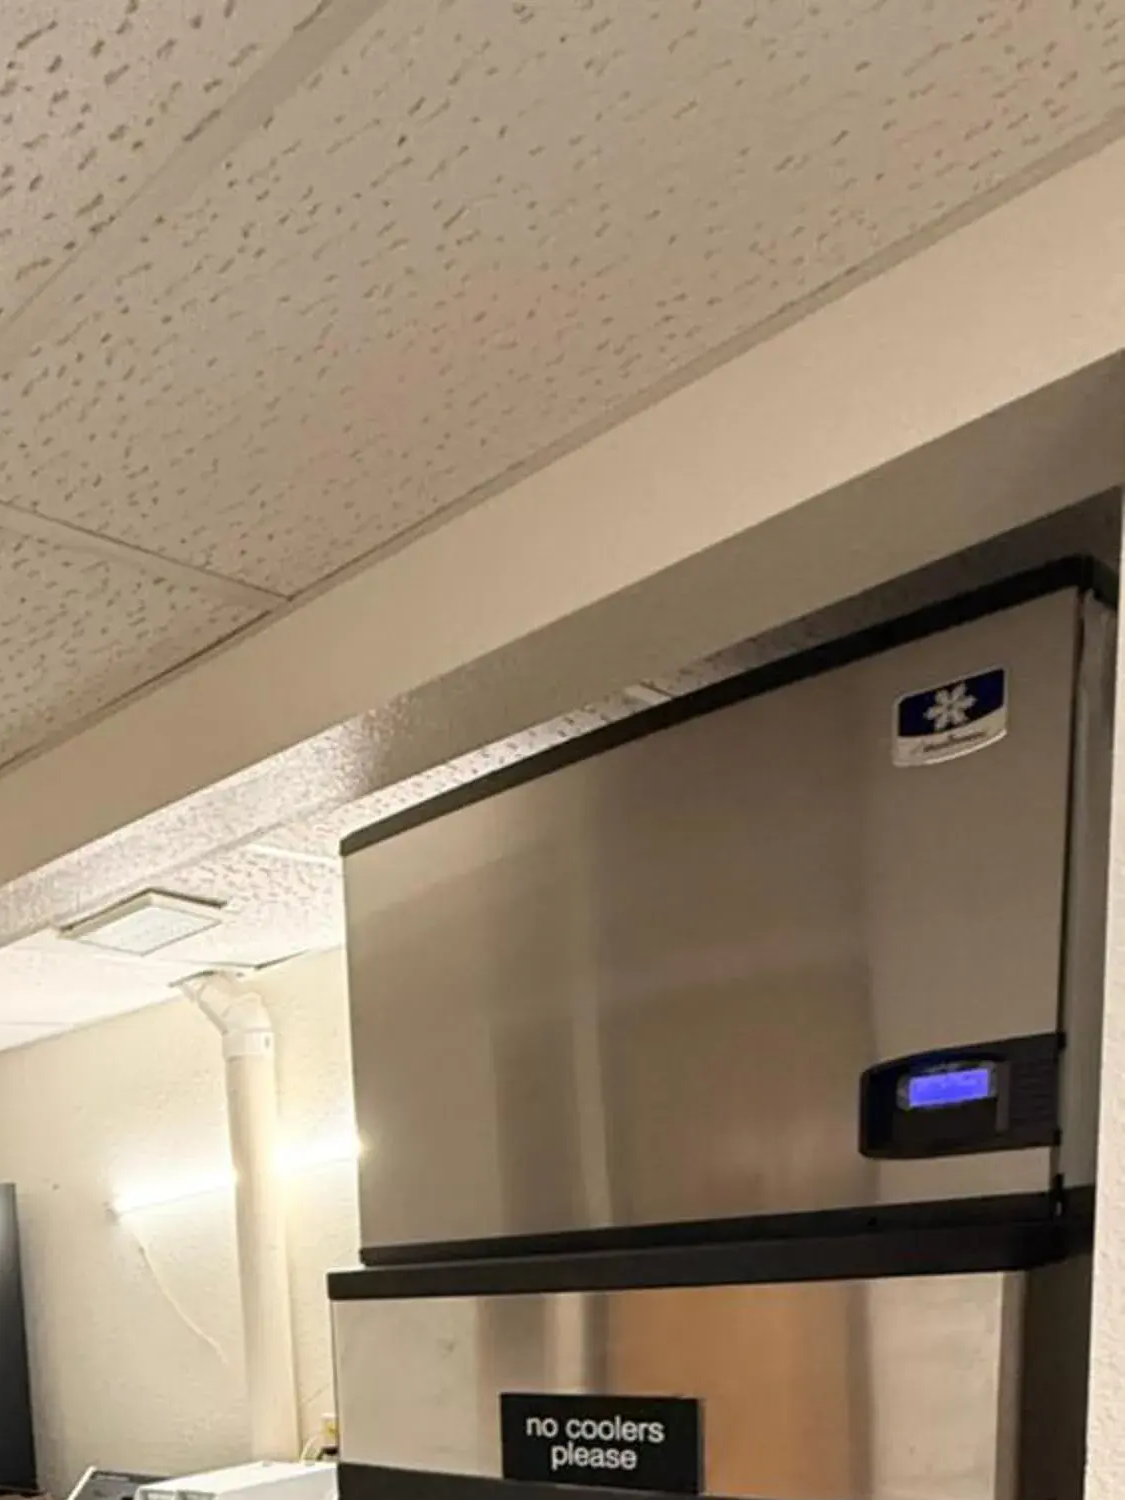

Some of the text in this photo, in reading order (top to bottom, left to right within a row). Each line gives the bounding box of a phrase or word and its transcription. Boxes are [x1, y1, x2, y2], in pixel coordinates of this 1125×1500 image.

[526, 1414, 666, 1443] no coolers
[551, 1440, 638, 1471] please
